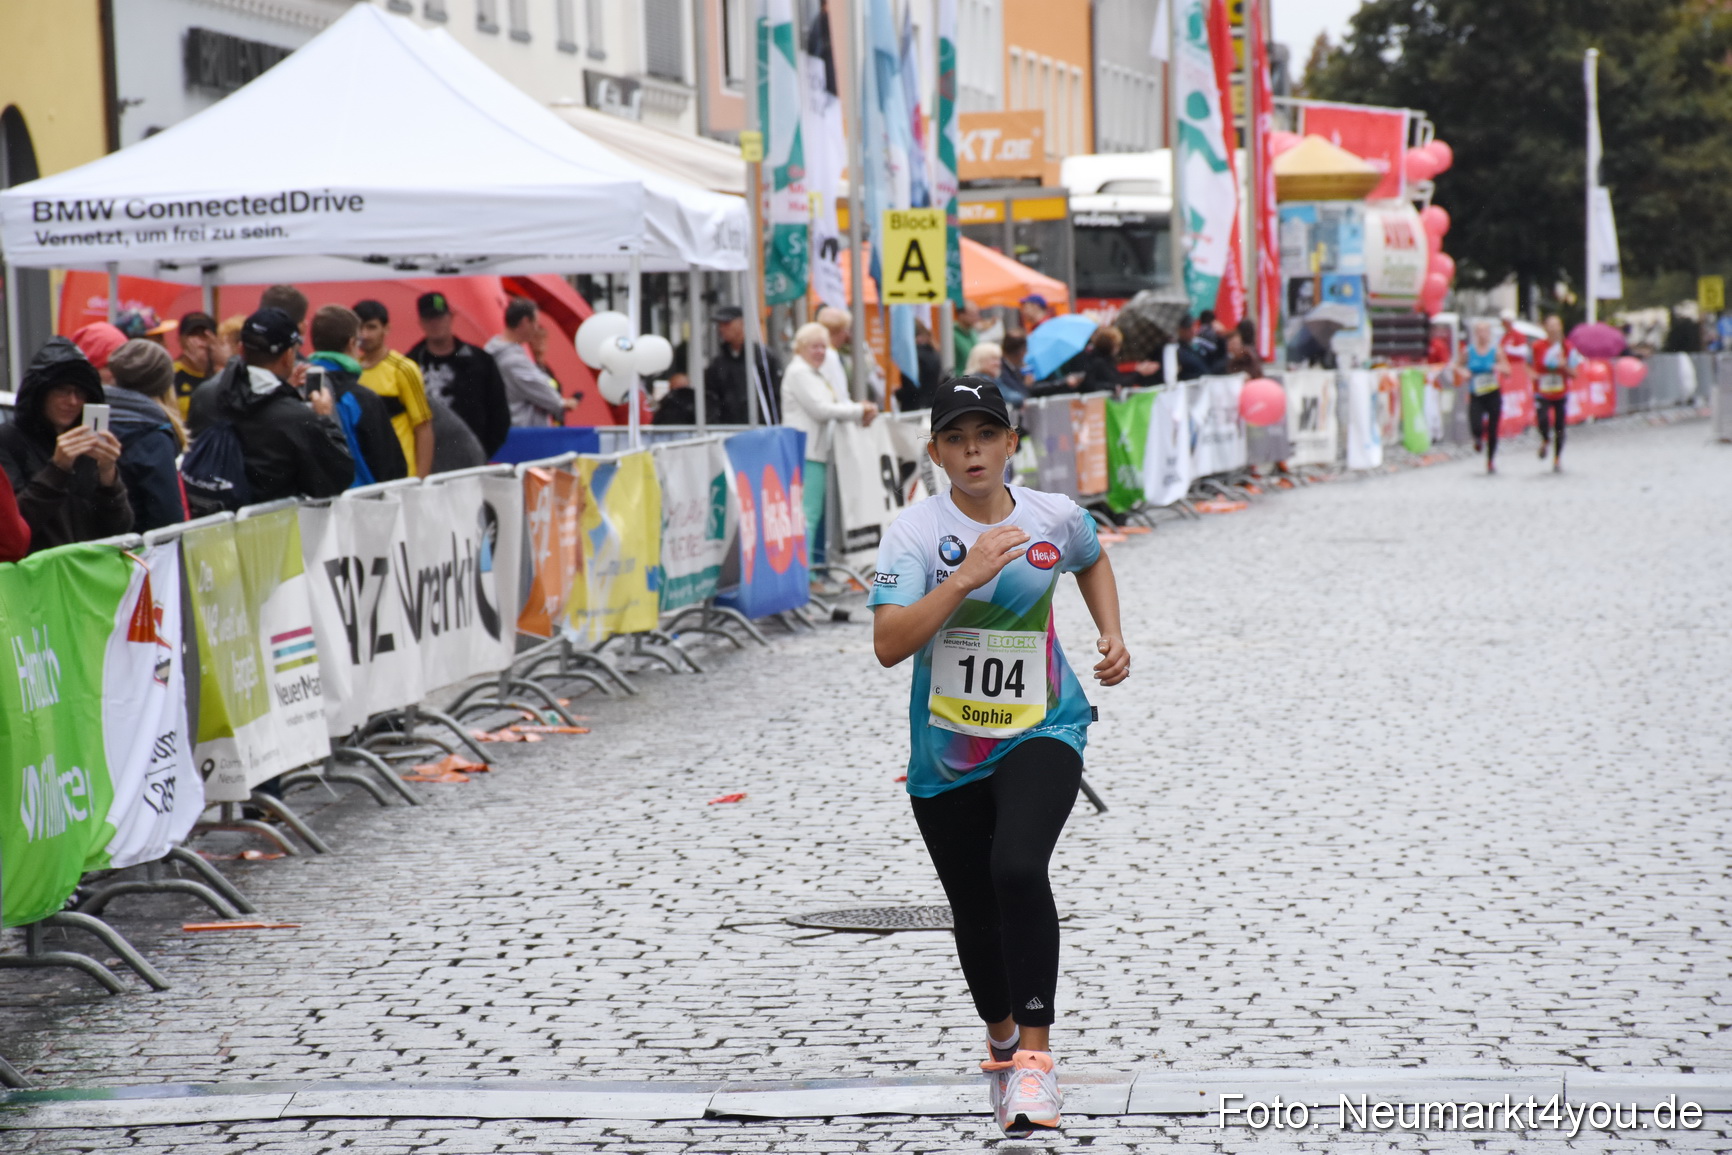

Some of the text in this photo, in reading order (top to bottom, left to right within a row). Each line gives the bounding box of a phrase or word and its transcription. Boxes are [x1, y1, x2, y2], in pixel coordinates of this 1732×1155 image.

[33, 189, 365, 223] BMW ConnectedDrive
[891, 214, 939, 230] Block
[35, 223, 289, 248] Vernetzt, um frei zu sein.
[897, 238, 931, 282] A
[943, 639, 981, 648] NeuerMarkt
[987, 634, 1037, 649] BOCK
[958, 655, 1025, 698] 104
[961, 705, 1013, 726] Sophia
